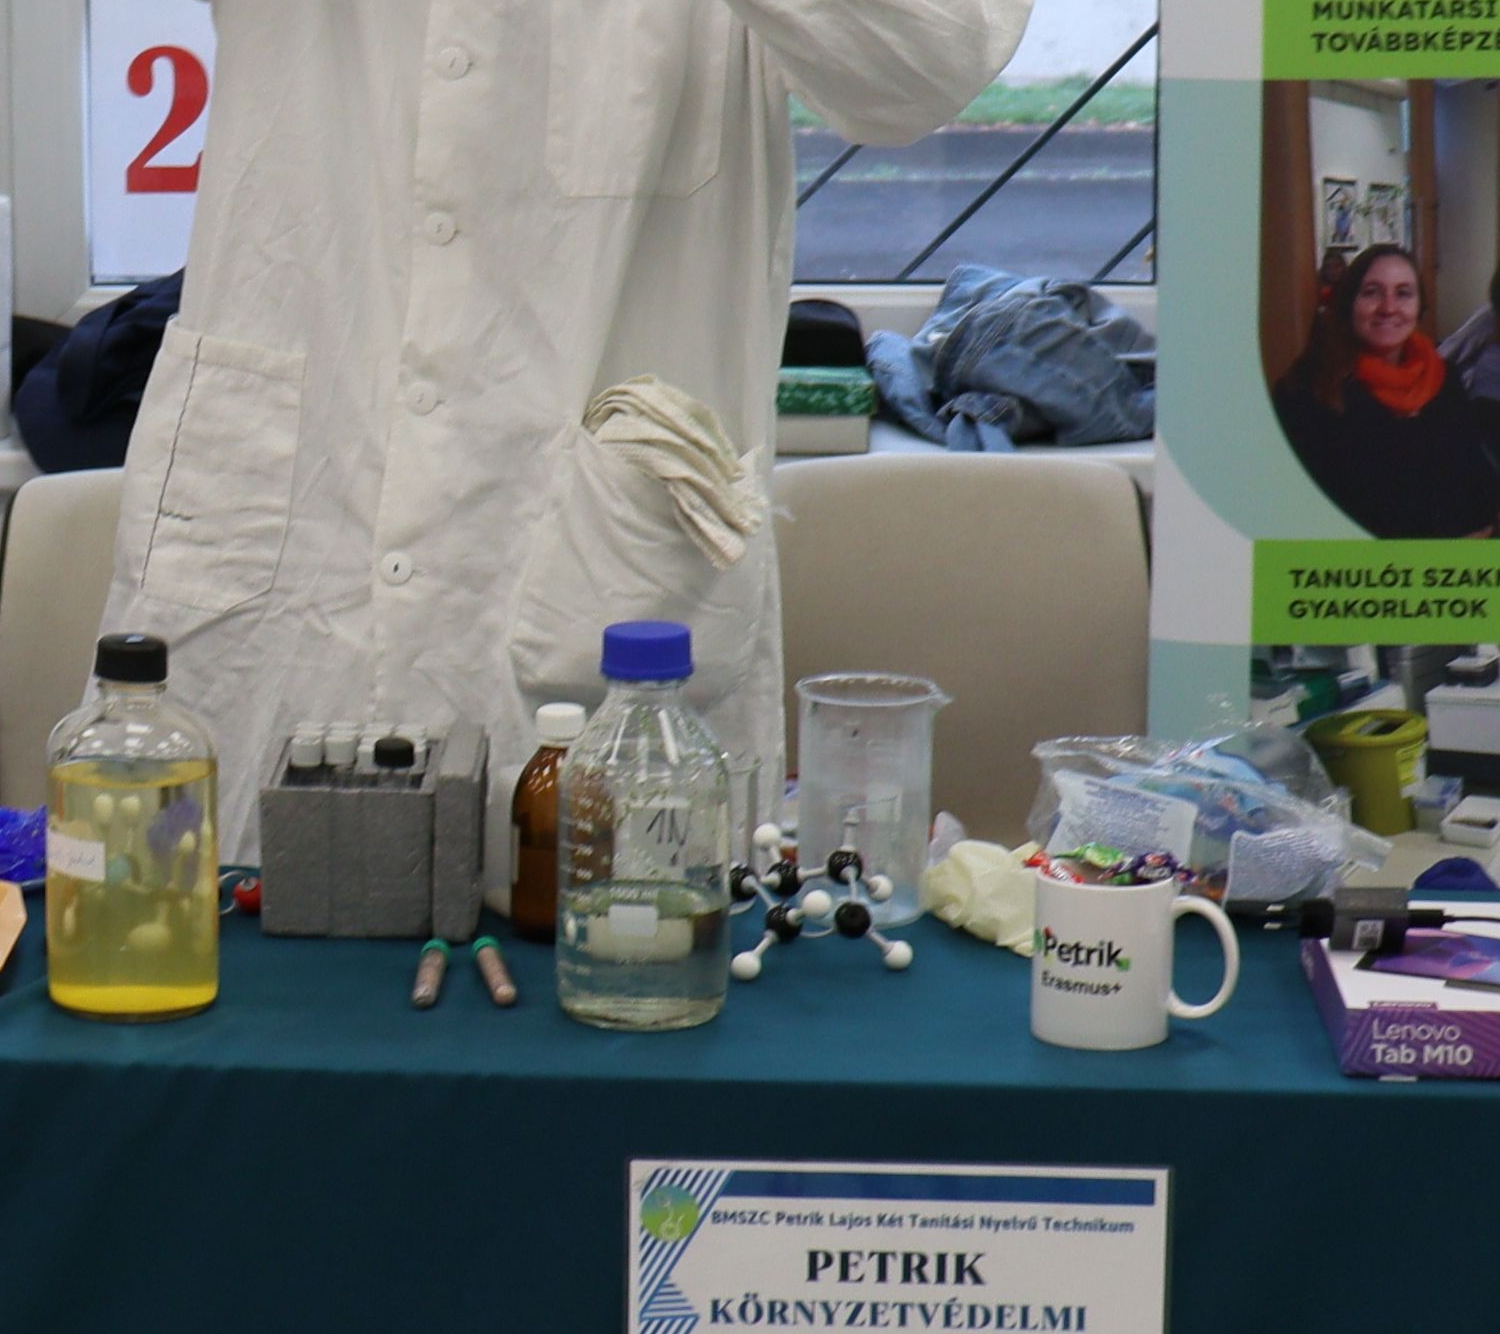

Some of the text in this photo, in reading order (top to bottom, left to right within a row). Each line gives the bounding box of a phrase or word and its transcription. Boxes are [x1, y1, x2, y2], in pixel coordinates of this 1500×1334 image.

[125, 44, 209, 195] 2
[1289, 563, 1413, 589] TANULÓI
[1288, 598, 1488, 619] GYAKORLATOK
[1043, 933, 1123, 968] Petrik
[1372, 1018, 1462, 1042] Lenovo
[1370, 1043, 1474, 1066] Tab M10
[775, 1210, 823, 1227] Petrik
[829, 1213, 872, 1230] Lajos
[877, 1213, 903, 1228] Két
[1043, 1216, 1135, 1234] Technikum
[805, 1249, 987, 1285] PETRIK
